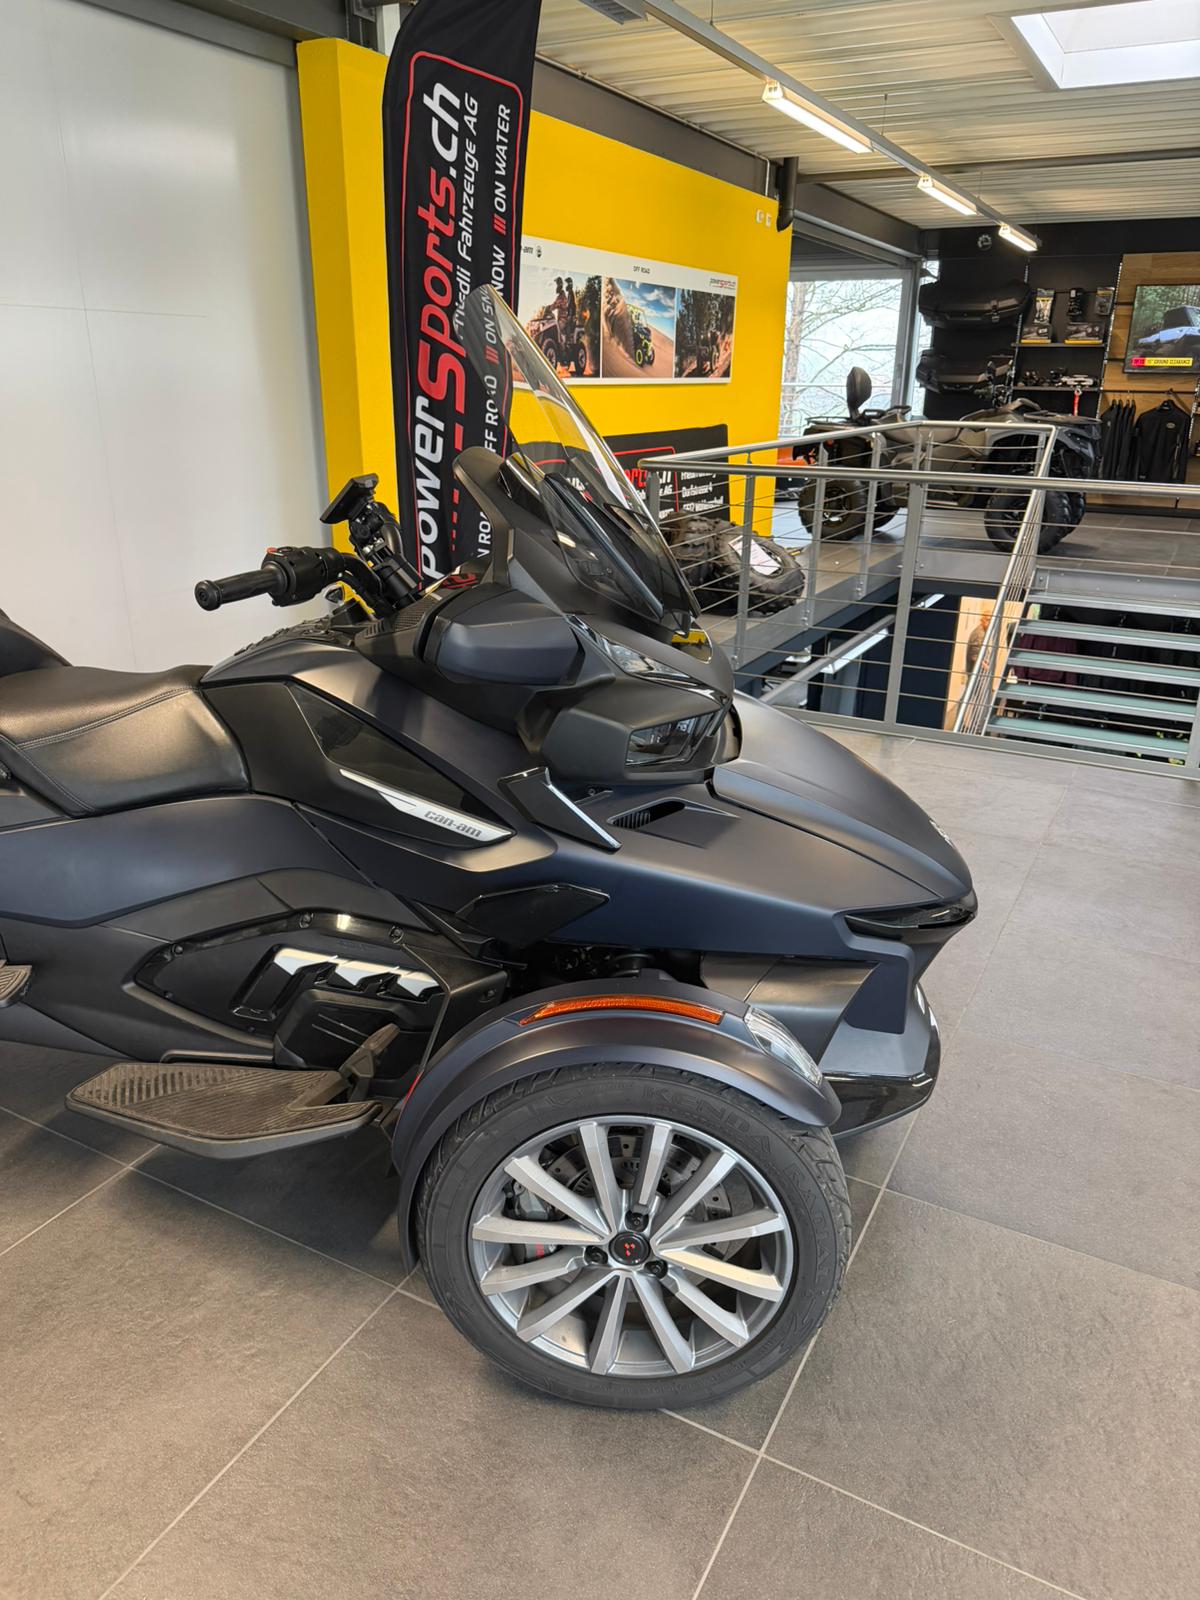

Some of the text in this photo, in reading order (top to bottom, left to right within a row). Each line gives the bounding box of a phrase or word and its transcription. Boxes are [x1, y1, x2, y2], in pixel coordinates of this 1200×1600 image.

[464, 92, 478, 136] AG
[494, 104, 511, 176] WATER
[458, 138, 478, 262] Fahrzeuge
[494, 181, 507, 213] ON
[484, 317, 497, 345] ON
[484, 429, 498, 453] FF
[478, 512, 492, 546] ROA
[424, 810, 482, 838] can-am
[642, 1083, 773, 1158] KENDA
